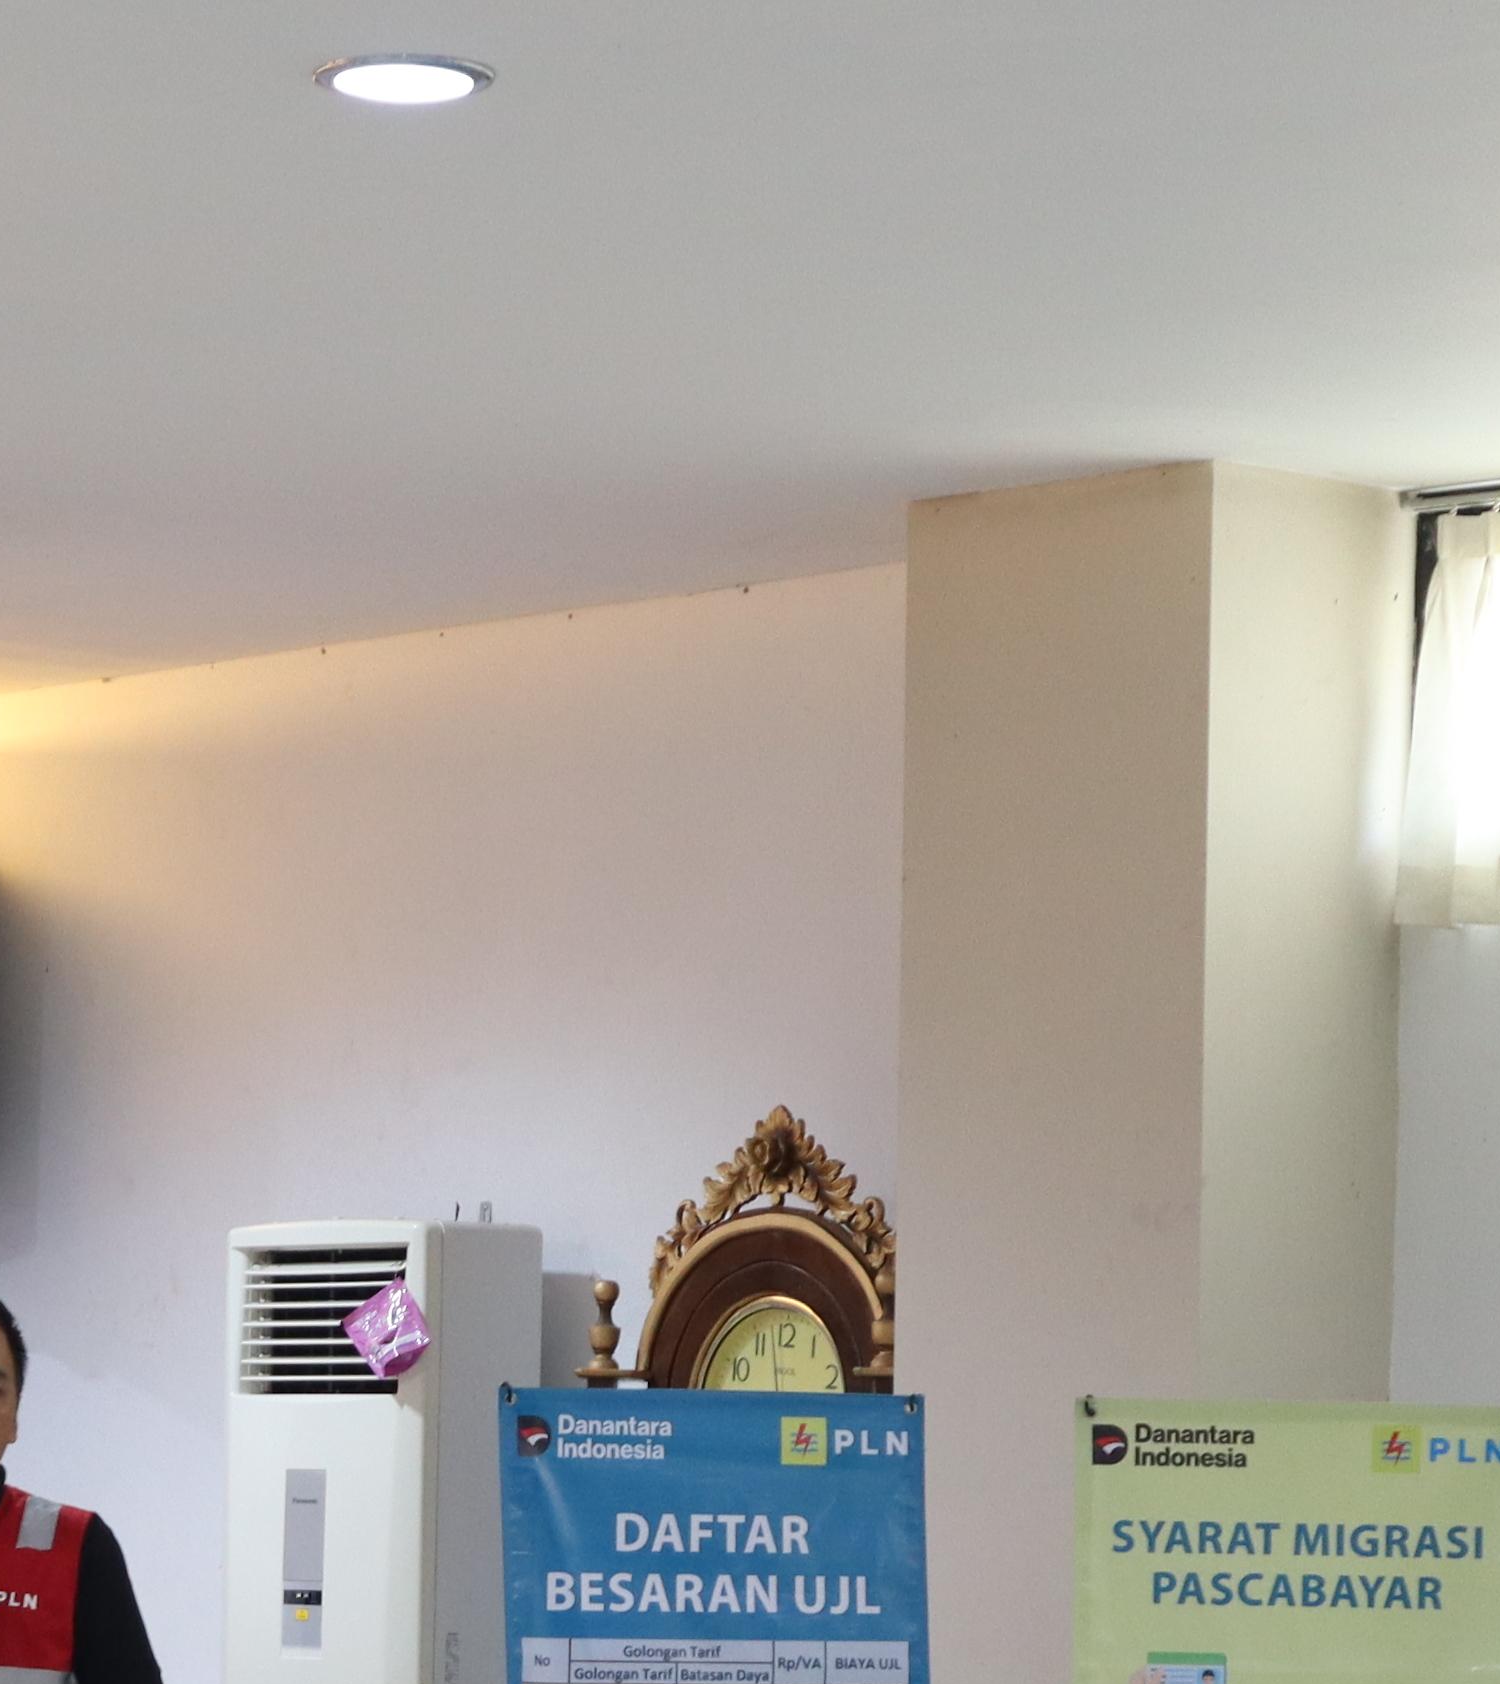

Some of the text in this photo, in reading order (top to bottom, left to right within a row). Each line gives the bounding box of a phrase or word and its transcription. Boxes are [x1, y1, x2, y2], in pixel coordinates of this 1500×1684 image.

[755, 1332, 766, 1357] 11
[778, 1323, 796, 1349] 12
[732, 1358, 750, 1383] 10
[825, 1364, 839, 1390] 2
[557, 1413, 673, 1437] Danantara
[1134, 1423, 1255, 1446] Danantara
[556, 1437, 666, 1460] Indonesia
[834, 1429, 909, 1456] PLN
[1134, 1447, 1248, 1468] Indonesia
[615, 1513, 811, 1554] DAFTAR
[1112, 1520, 1484, 1559] SYARAT MIGRASI
[546, 1572, 882, 1615] BESARAN UJL
[1151, 1572, 1443, 1610] PASCABAYAR
[534, 1655, 550, 1667] No
[623, 1644, 721, 1660] Golongan Tarif
[834, 1656, 901, 1671] BIAYA UJL
[574, 1667, 675, 1683] Golongan Tarif
[680, 1668, 770, 1684] Batasan Daya
[778, 1657, 821, 1673] Rp/VA
